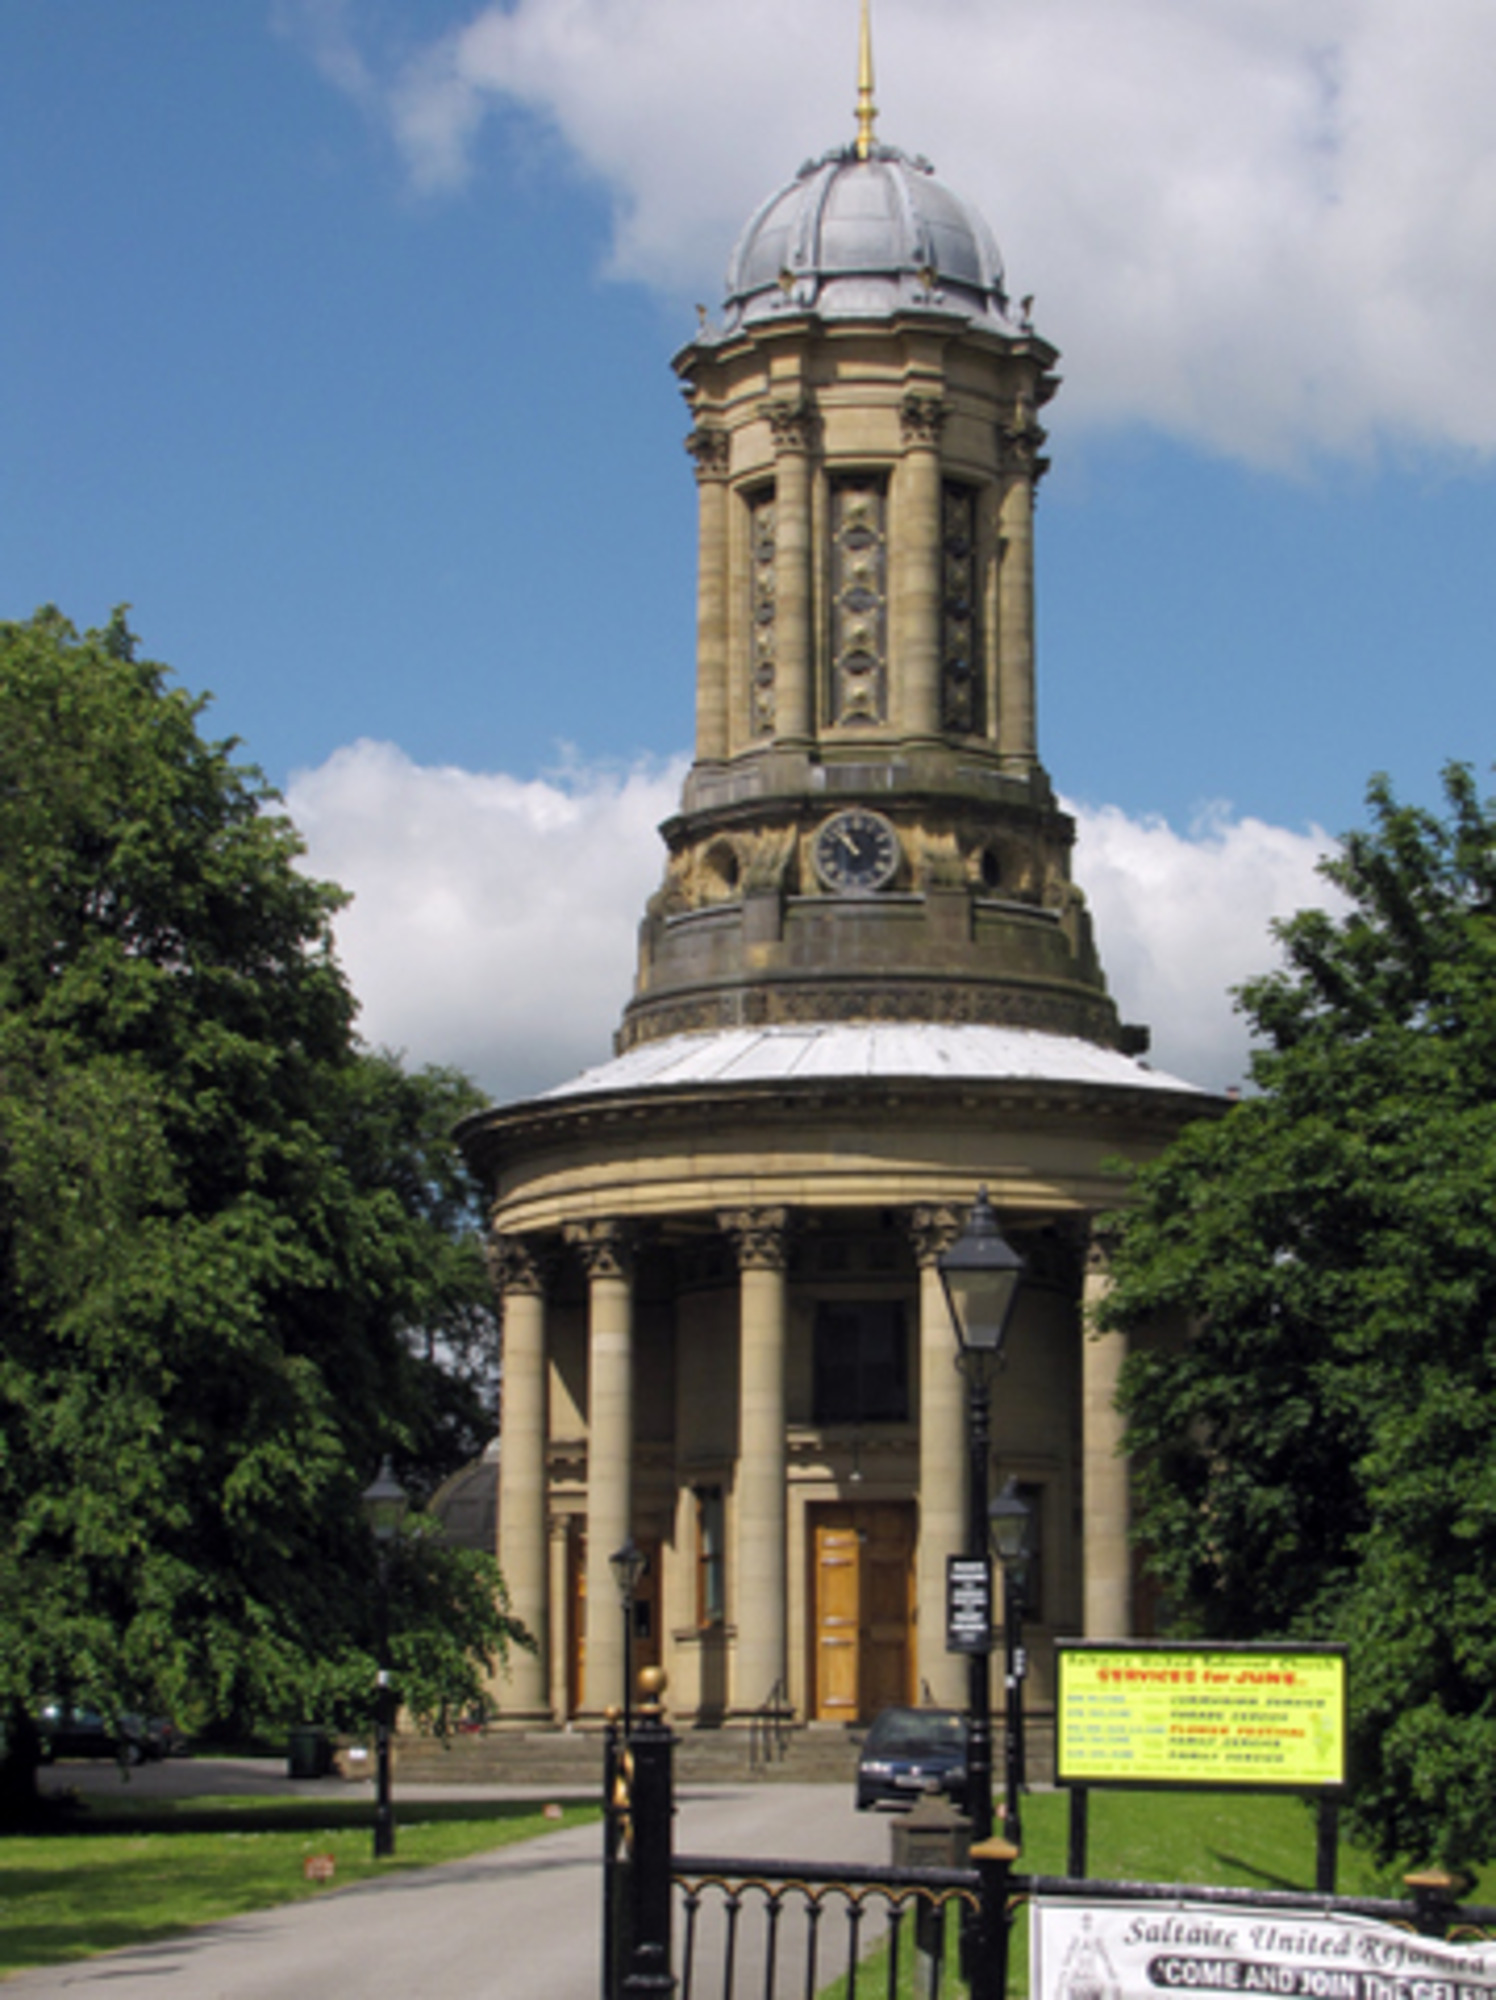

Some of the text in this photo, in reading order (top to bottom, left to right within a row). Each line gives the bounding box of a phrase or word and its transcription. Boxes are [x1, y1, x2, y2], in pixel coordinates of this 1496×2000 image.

[1097, 1668, 1197, 1684] SERVICES
[1123, 1914, 1485, 1974] Saltaire United Reformed
[1244, 1964, 1296, 1993] AND
[1299, 1970, 1357, 1998] JOIN
[1412, 1983, 1496, 2000] CELE
